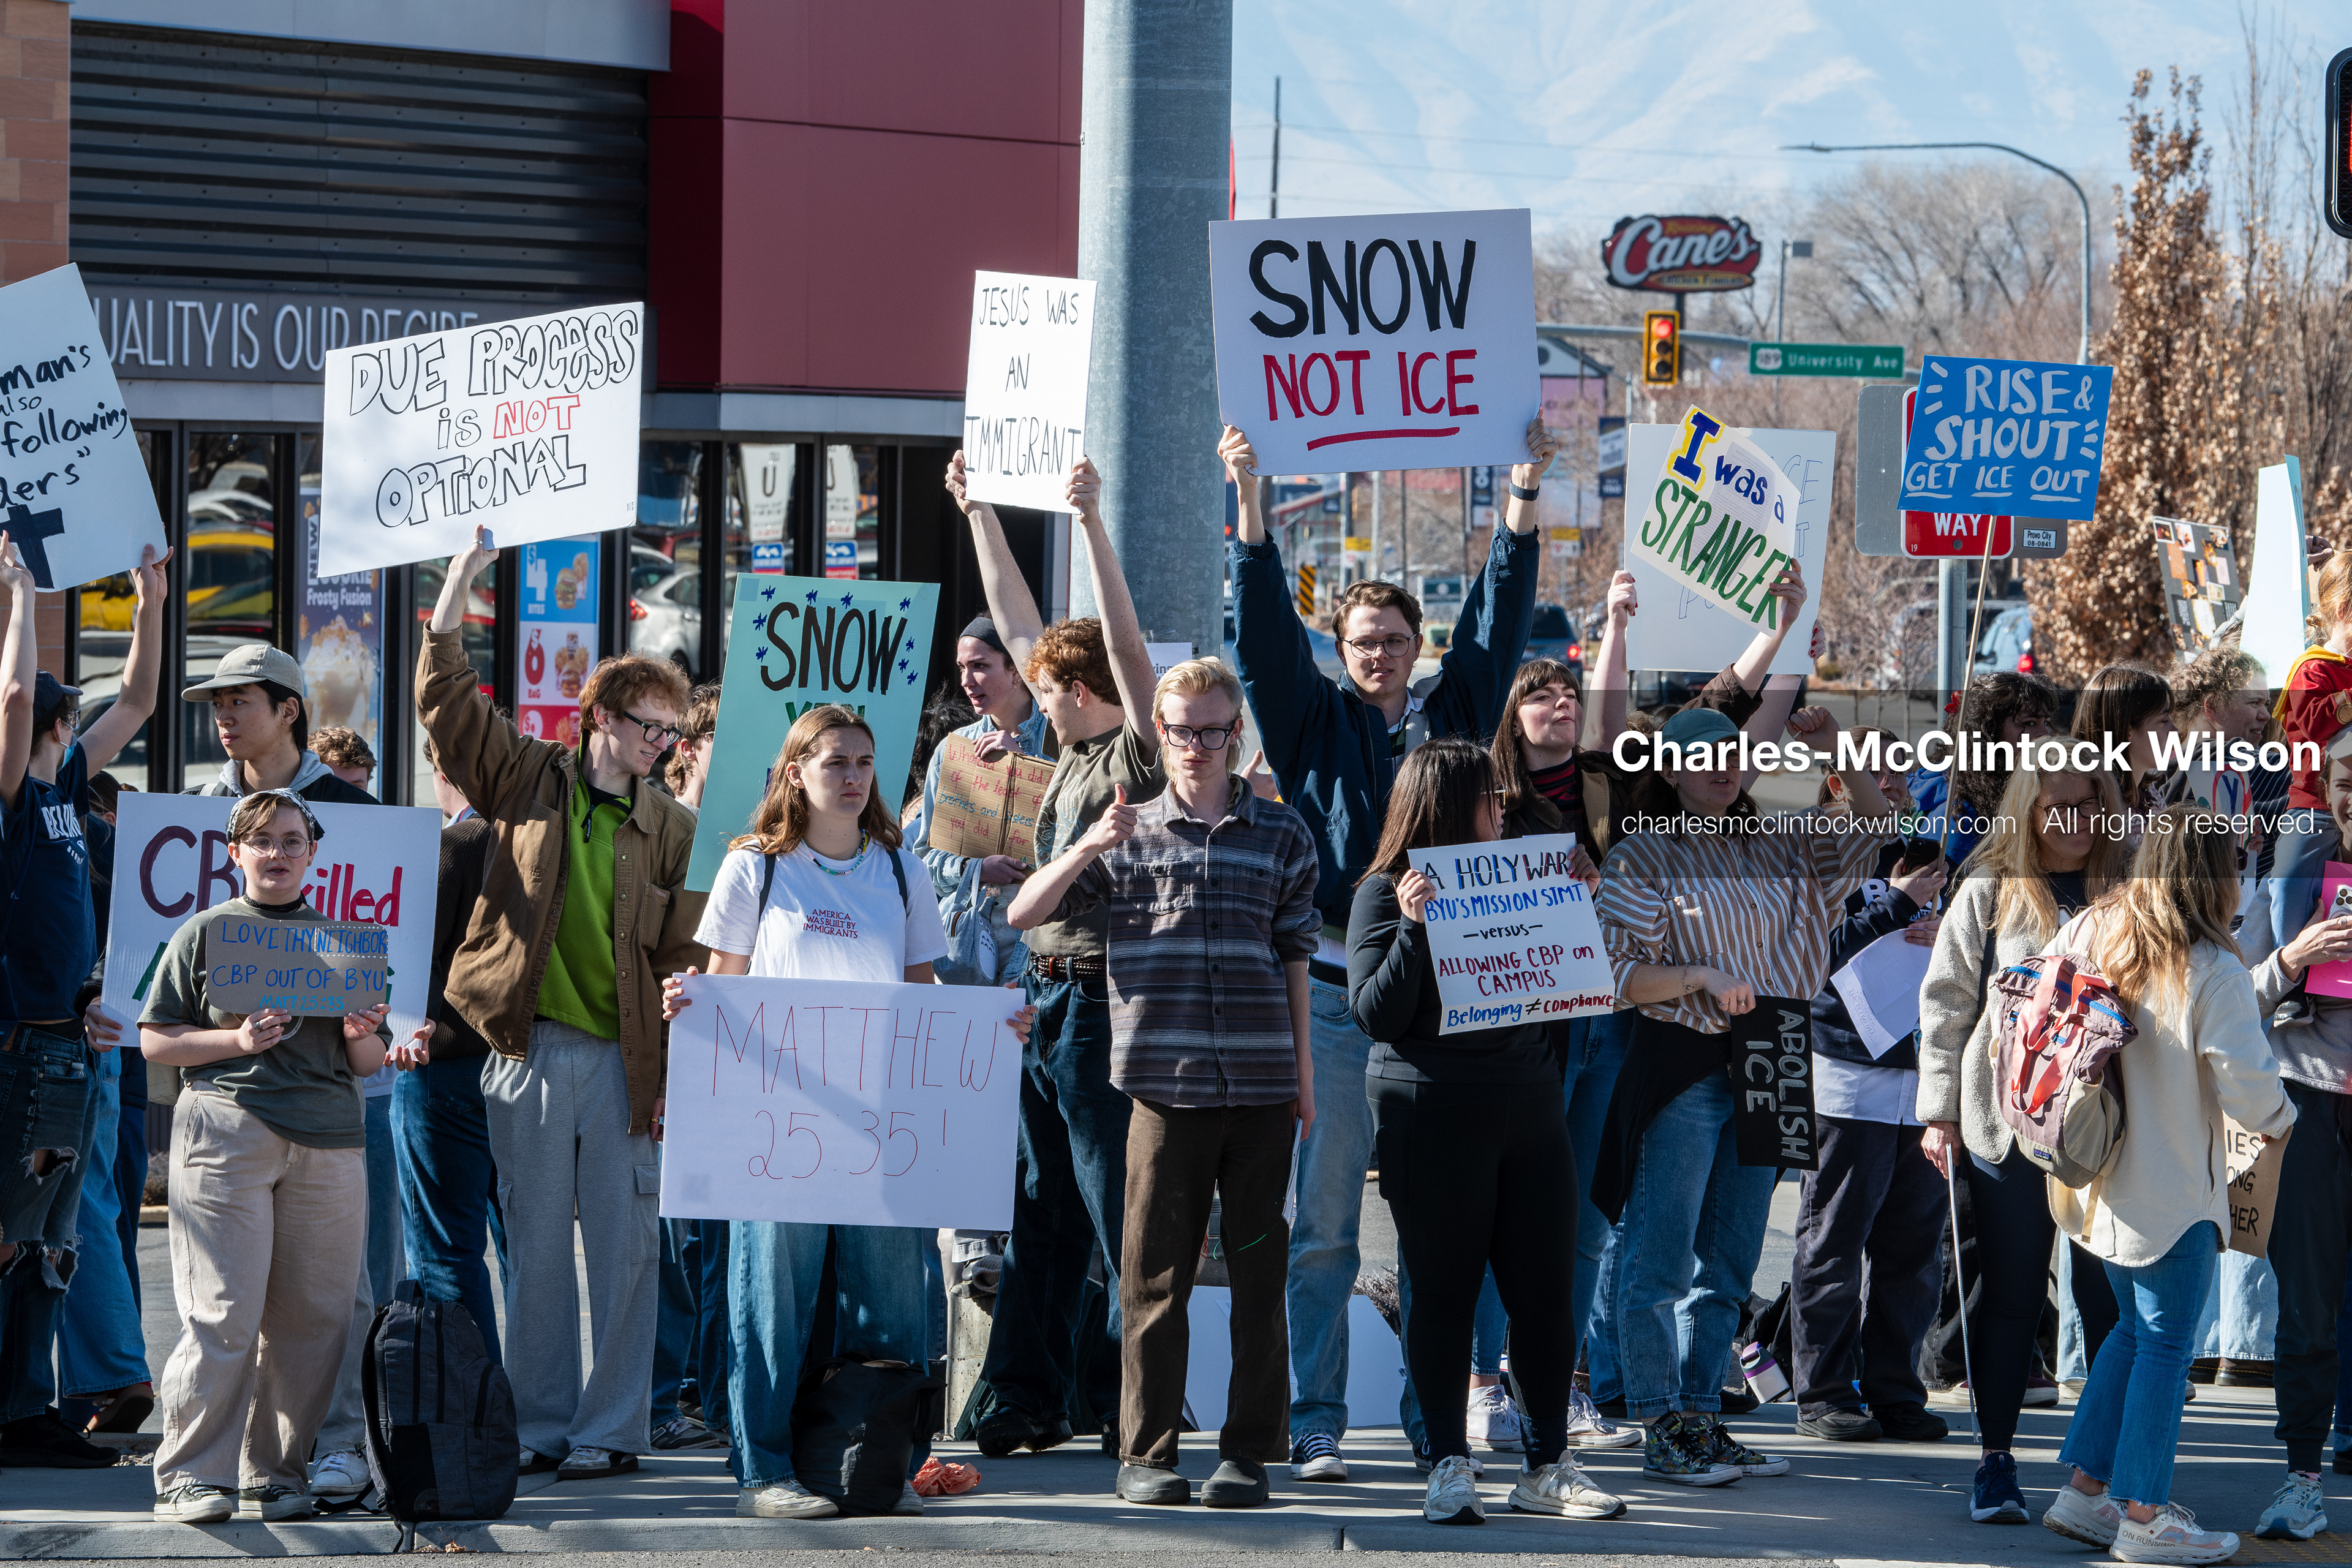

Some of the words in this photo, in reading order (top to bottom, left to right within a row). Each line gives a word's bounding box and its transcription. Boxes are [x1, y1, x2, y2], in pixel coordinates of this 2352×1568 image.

[1611, 216, 1757, 286] Cane's
[1249, 238, 1476, 338] SNOW
[979, 283, 1029, 327] JESUS
[1046, 293, 1079, 325] WAS
[92, 298, 222, 368] UALITY
[232, 303, 260, 369] IS
[350, 338, 447, 416] DUE
[468, 309, 638, 396] PROCESS
[1005, 353, 1030, 393] AN
[1787, 352, 1864, 372] University
[1873, 353, 1899, 369] Ave
[1263, 350, 1370, 421] NOT
[1398, 349, 1479, 417] ICE
[1964, 365, 2071, 415] RISE
[2073, 375, 2094, 411] &
[1, 401, 127, 458] following
[493, 394, 580, 439] NOT
[964, 415, 1080, 476] IMMIGRANT
[1924, 415, 2081, 461] SHOUT
[1673, 412, 1721, 484] I
[1715, 455, 1768, 505] was
[1774, 494, 1784, 524] a
[1905, 462, 1962, 492] GET
[1975, 465, 2016, 490] ICE
[2030, 466, 2090, 494] OUT
[1934, 513, 1981, 536] WAY
[2027, 530, 2040, 539] Provo
[2042, 532, 2052, 540] City
[1642, 478, 1793, 630] STRANGER
[1911, 544, 1917, 552] 19
[307, 587, 339, 610] Frosty
[341, 586, 372, 605] Fusion
[761, 601, 908, 696] SNOW
[950, 770, 963, 792] of
[973, 775, 988, 792] the
[993, 777, 1023, 798] least
[1028, 768, 1042, 784] did
[981, 804, 998, 818] and
[973, 820, 989, 838] did
[1011, 830, 1030, 850] for
[139, 825, 246, 918] CB
[1425, 862, 1446, 889] A
[1455, 854, 1518, 890] HOLY
[1523, 851, 1568, 881] WAR
[812, 909, 851, 921] AMERICA
[1425, 897, 1470, 922] BYU'S
[1472, 889, 1538, 917] MISSION
[1540, 883, 1584, 907] STMT
[222, 921, 279, 949] LOVE
[285, 927, 315, 952] THY
[317, 930, 388, 954] NEIGHBOR
[803, 923, 858, 938] IMMIGRANTS
[807, 915, 824, 924] WAS
[825, 918, 845, 928] BUILT
[1439, 951, 1521, 978] ALLOWING
[1527, 944, 1564, 968] CBP
[1572, 946, 1594, 960] on
[212, 965, 258, 986] CBP
[265, 968, 304, 989] OUT
[306, 968, 336, 989] OF
[345, 968, 384, 991] BYU
[1477, 970, 1556, 997] CAMPUS
[258, 995, 298, 1009] MATT
[300, 997, 344, 1011] 25:35
[1447, 1003, 1522, 1028] Belonging
[713, 1001, 997, 1096] MATTHEW
[1745, 1041, 1776, 1113] ICE
[1777, 1009, 1810, 1160] ABOLISH
[2227, 1129, 2261, 1161] IES
[2227, 1166, 2256, 1194] ONG
[2230, 1204, 2259, 1237] HER
[2122, 1530, 2135, 1542] ON
